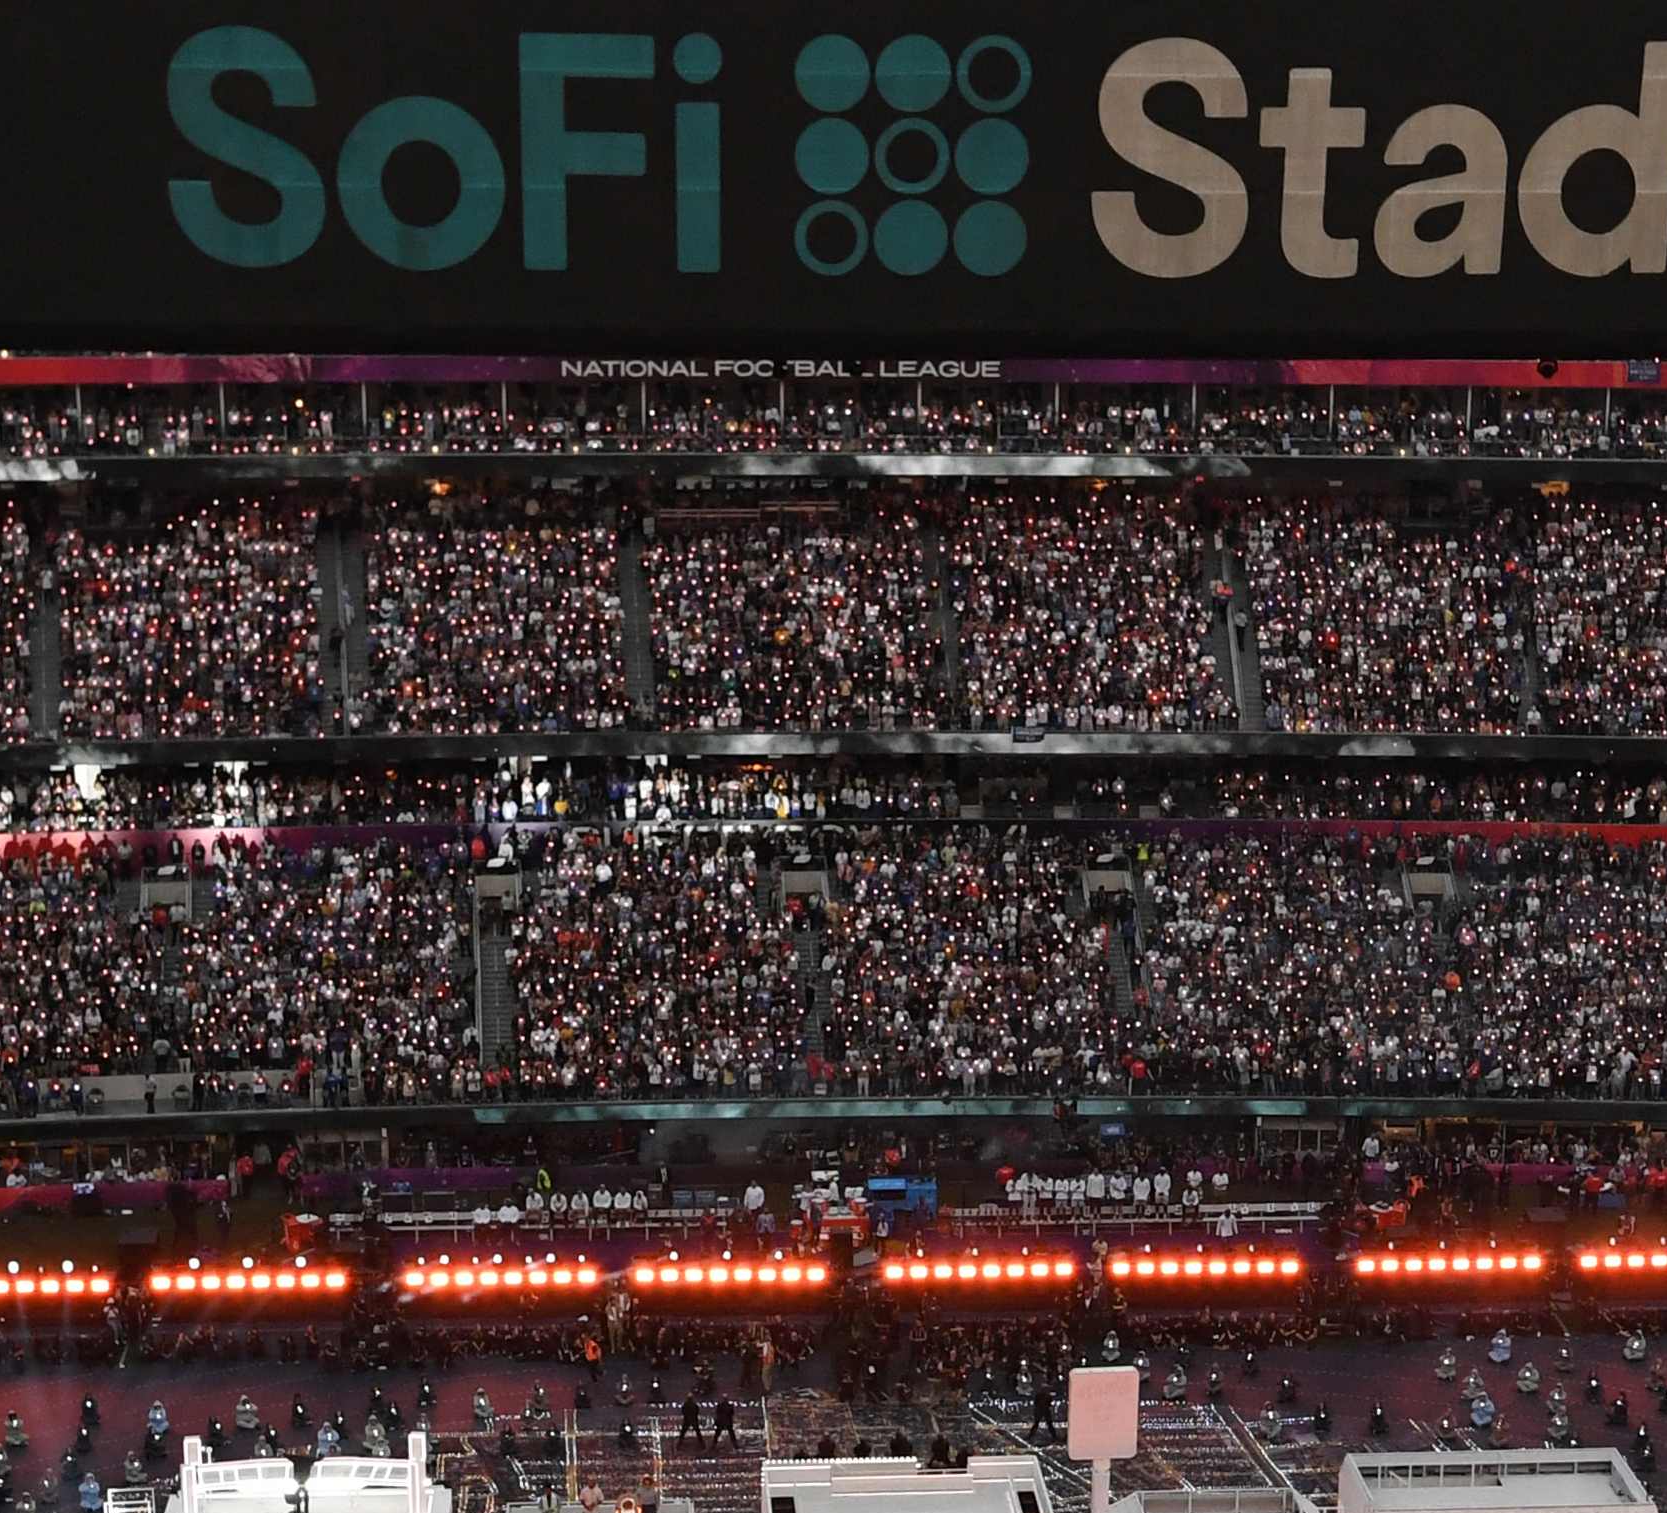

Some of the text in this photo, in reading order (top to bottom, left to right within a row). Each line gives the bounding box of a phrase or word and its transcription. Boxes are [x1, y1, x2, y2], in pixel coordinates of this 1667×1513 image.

[167, 24, 722, 273] SoFi
[560, 359, 708, 378] NATIONAL
[879, 359, 1001, 378] LEAGUE
